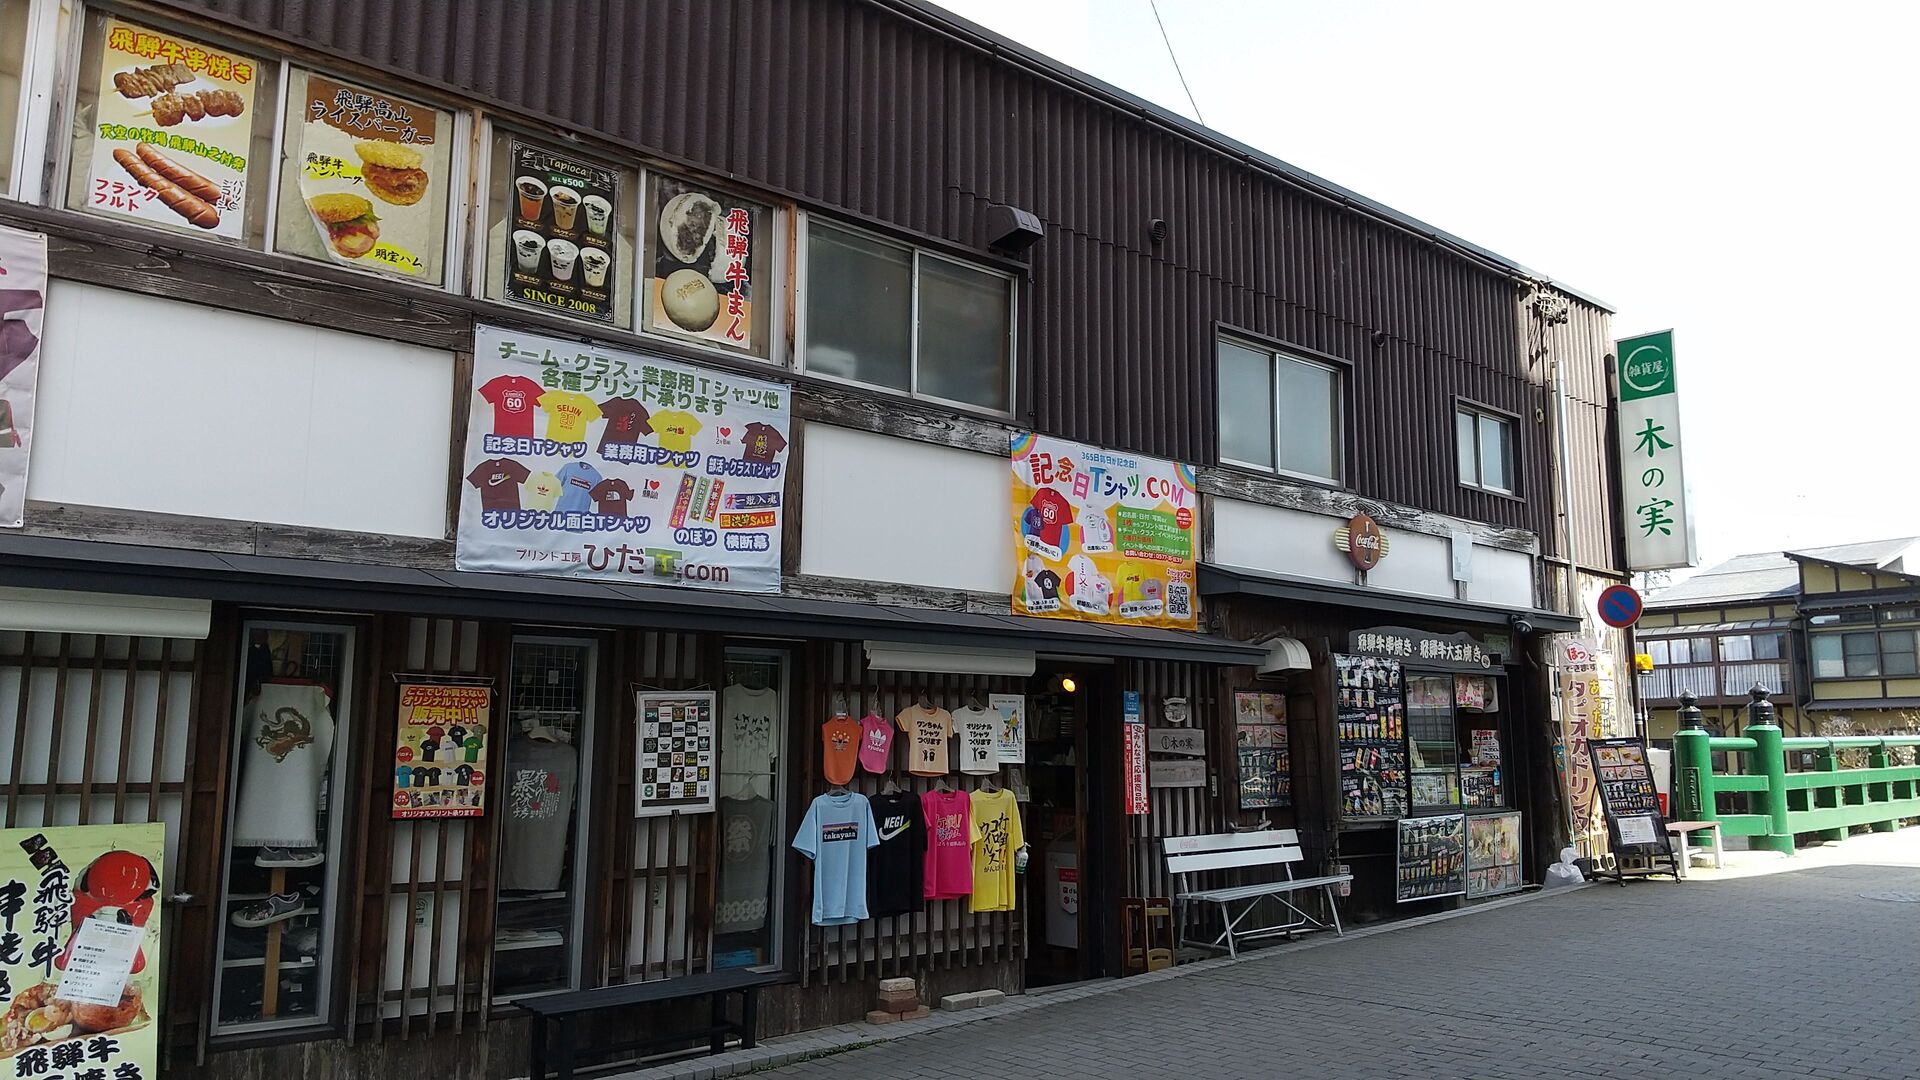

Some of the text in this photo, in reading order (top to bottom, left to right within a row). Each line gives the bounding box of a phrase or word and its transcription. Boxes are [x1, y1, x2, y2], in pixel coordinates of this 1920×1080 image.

[110, 27, 252, 84] 飛騨牛串焼き
[334, 88, 412, 124] 飛騨高山
[310, 102, 433, 144] ライスバーガー
[98, 123, 168, 148] 天空の牧場
[306, 152, 344, 169] 飛騨牛
[548, 158, 588, 177] Tapioca
[304, 165, 363, 185] ハンバーグ
[551, 175, 563, 184] ALL
[96, 178, 159, 202] フランク
[95, 192, 139, 212] フルト
[374, 248, 423, 268] 明宝ハム
[725, 208, 750, 342] 飛騨牛まん
[523, 288, 596, 314] SINCE 2008
[1628, 361, 1664, 378] 雑貨屋
[541, 368, 728, 416] 各種プリント承ります
[506, 398, 522, 409] 60
[557, 404, 582, 417] SEIJIN
[560, 412, 575, 427] 20
[485, 436, 586, 457] 記念日Tシャツ
[604, 443, 699, 467] 業務用Tシャツ
[1634, 418, 1674, 538] 木の実
[484, 511, 649, 532] オリジナル面白Tシャツ
[1043, 508, 1054, 519] 60
[675, 529, 716, 544] のぼり
[725, 533, 768, 551] 横断幕
[516, 549, 581, 562] プリント工房
[1567, 647, 1595, 661] ほっと
[1564, 664, 1596, 673] できます
[407, 687, 486, 698] ここでしか買えない
[402, 696, 488, 708] オリジナルTシャツ
[409, 706, 478, 725] 販売中!!
[916, 720, 943, 730] ワンちゃん
[920, 729, 940, 738] Tシャツ
[966, 723, 992, 731] オリジナル
[917, 736, 942, 746] つくります
[968, 738, 992, 746] つくります
[1171, 737, 1193, 749] 木の実
[1568, 680, 1589, 832] タピオカドリンク
[401, 810, 475, 818] オリジナルプリント承ります
[884, 815, 904, 828] NEGI
[823, 831, 856, 841] takayama
[28, 868, 73, 979] 飛騨牛
[16, 1036, 120, 1078] 飛騨牛
